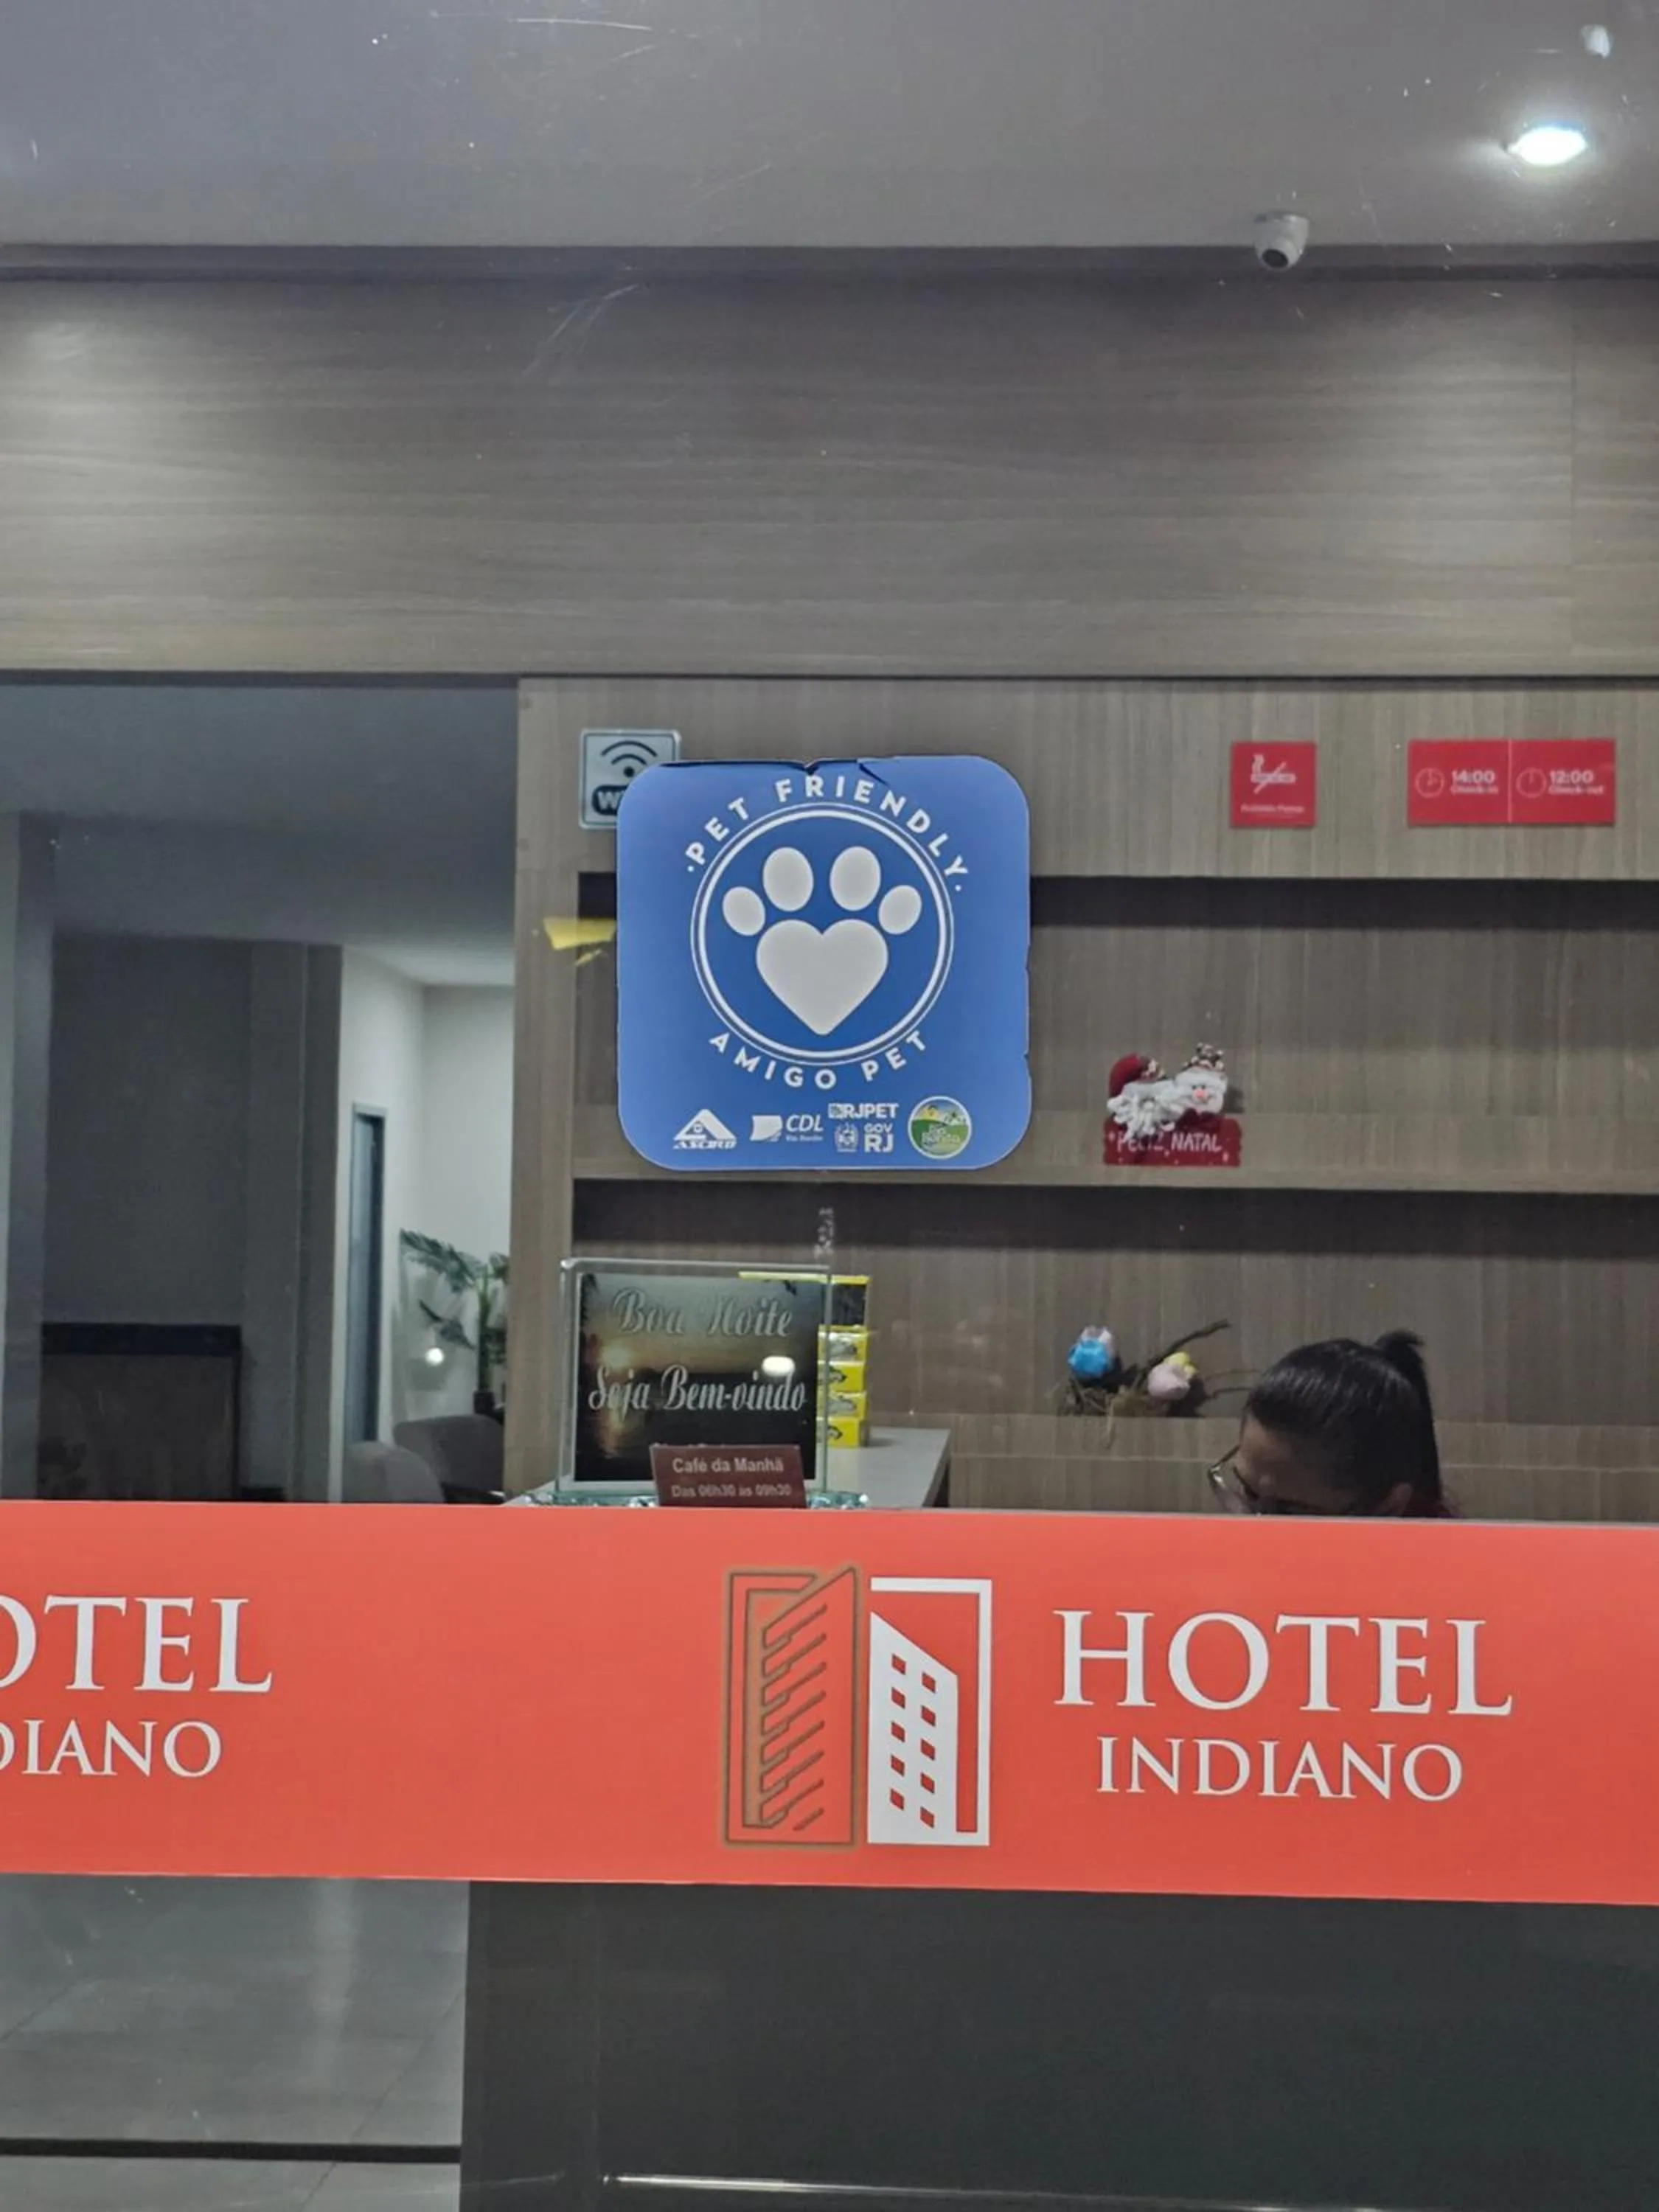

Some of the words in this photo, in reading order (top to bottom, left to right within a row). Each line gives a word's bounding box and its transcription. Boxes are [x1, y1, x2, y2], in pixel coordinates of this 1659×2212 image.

[1451, 769, 1495, 784] 14:00
[1549, 769, 1594, 784] 12:00
[685, 797, 751, 866] PET
[775, 775, 969, 877] FRIENDLY
[709, 1031, 837, 1090] AMIGO
[861, 1030, 926, 1082] PET
[786, 1114, 824, 1132] CDL
[863, 1123, 893, 1133] GOV
[864, 1134, 894, 1153] RJ
[1171, 1133, 1222, 1152] NATAL
[612, 1287, 683, 1335] Boa
[706, 1295, 793, 1338] Noite
[588, 1365, 650, 1422] Seja
[661, 1364, 807, 1412] Bem-vindo
[672, 1458, 708, 1473] Café
[711, 1458, 731, 1472] da
[734, 1457, 785, 1472] Manhã
[1052, 1610, 1512, 1717] HOTEL
[1096, 1736, 1463, 1801] INDIANO
